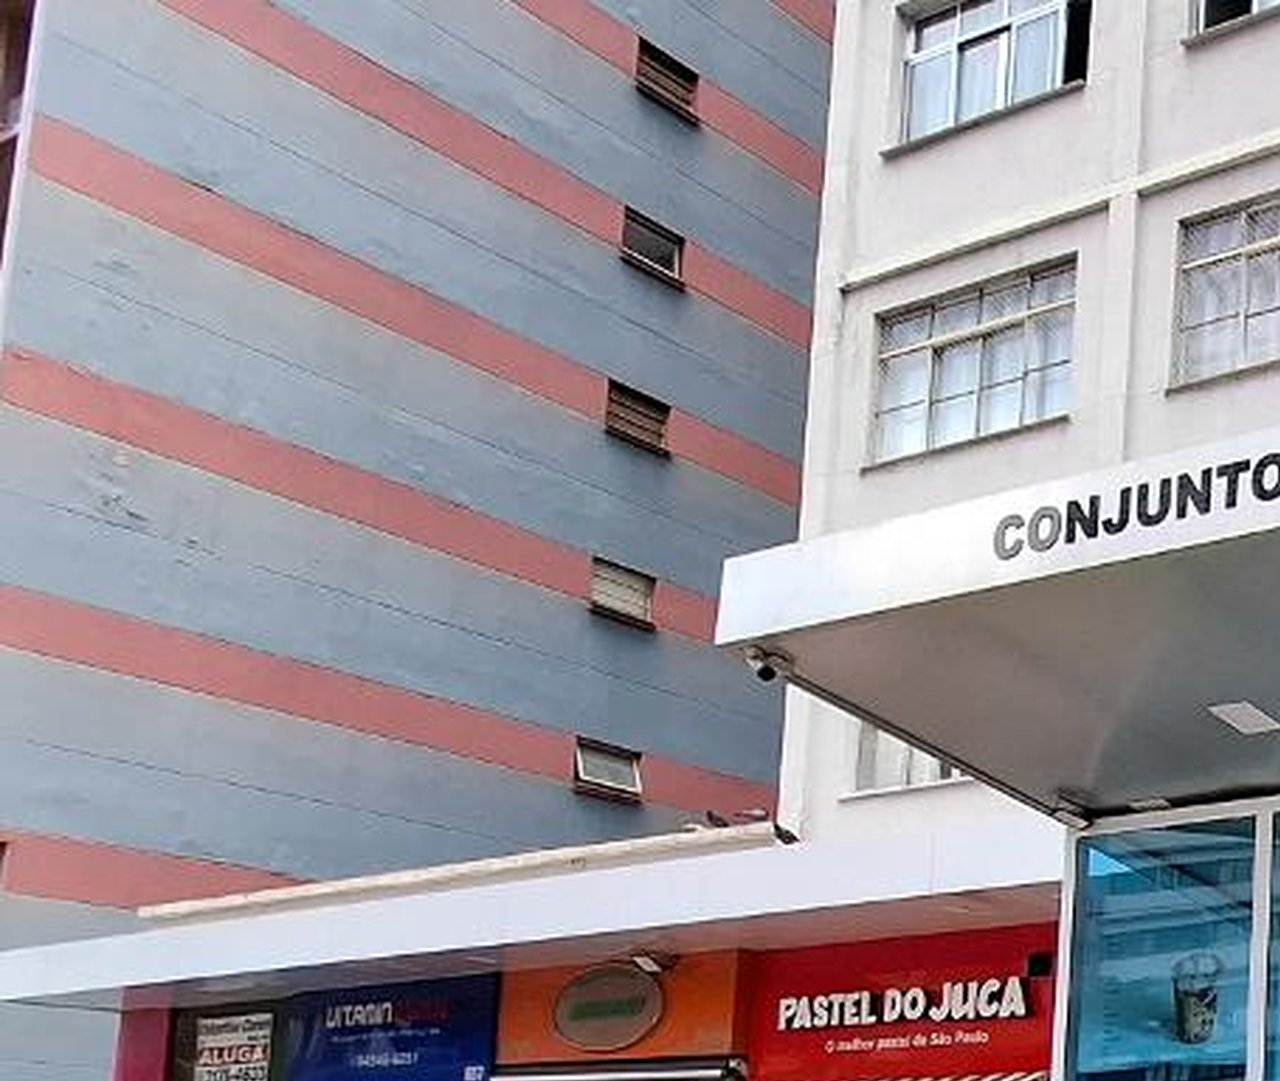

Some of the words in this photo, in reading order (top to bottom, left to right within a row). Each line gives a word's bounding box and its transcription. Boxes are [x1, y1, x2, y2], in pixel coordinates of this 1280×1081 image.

[777, 990, 877, 1031] PASTEL
[883, 987, 926, 1022] DO
[928, 975, 1026, 1022] JUCA
[954, 1029, 990, 1045] Paulo
